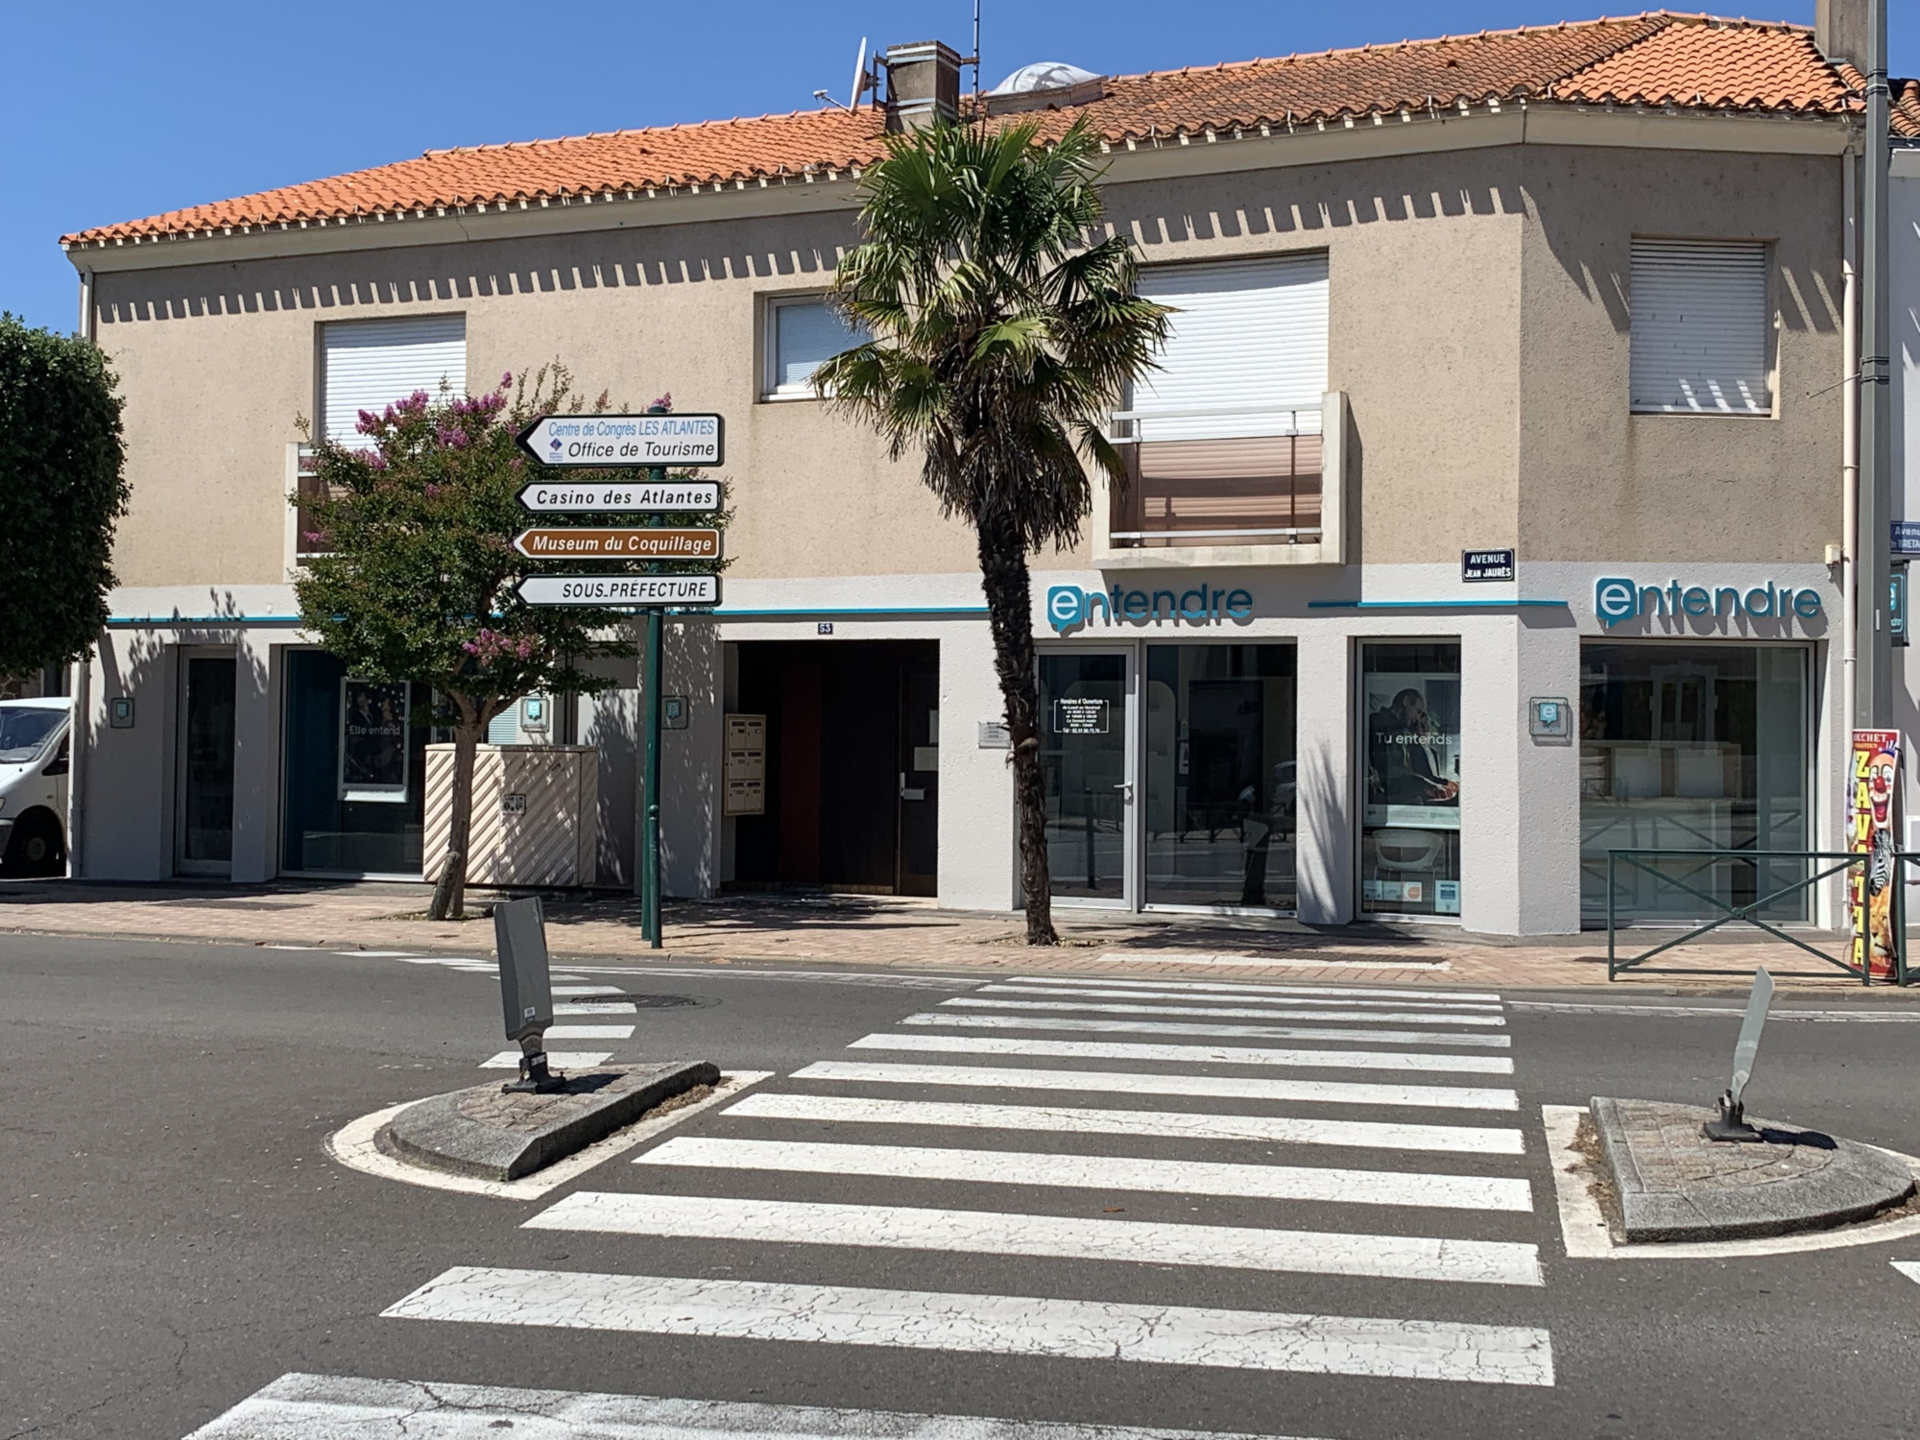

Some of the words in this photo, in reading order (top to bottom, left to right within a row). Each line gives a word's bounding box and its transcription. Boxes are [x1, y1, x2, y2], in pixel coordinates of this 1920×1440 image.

[549, 421, 580, 437] Centre
[583, 421, 595, 436] de
[597, 420, 636, 439] Congrès
[639, 420, 659, 436] LES
[661, 419, 714, 436] ATLANTES
[568, 442, 614, 457] Office
[619, 442, 639, 457] de
[645, 441, 714, 457] Tourisme
[537, 490, 594, 504] Casino
[603, 490, 632, 504] des
[640, 489, 712, 504] Atlantes
[533, 536, 599, 550] Museum
[604, 536, 623, 551] du
[628, 535, 712, 554] Coquillage
[1470, 554, 1506, 564] AVENUE
[1049, 583, 1253, 622] entendre
[1599, 579, 1821, 620] entendre
[820, 624, 831, 633] 53
[1543, 706, 1555, 718] e
[349, 725, 367, 735] Elle
[368, 725, 400, 735] entend
[1376, 732, 1393, 745] Tu
[1395, 732, 1453, 746] entends
